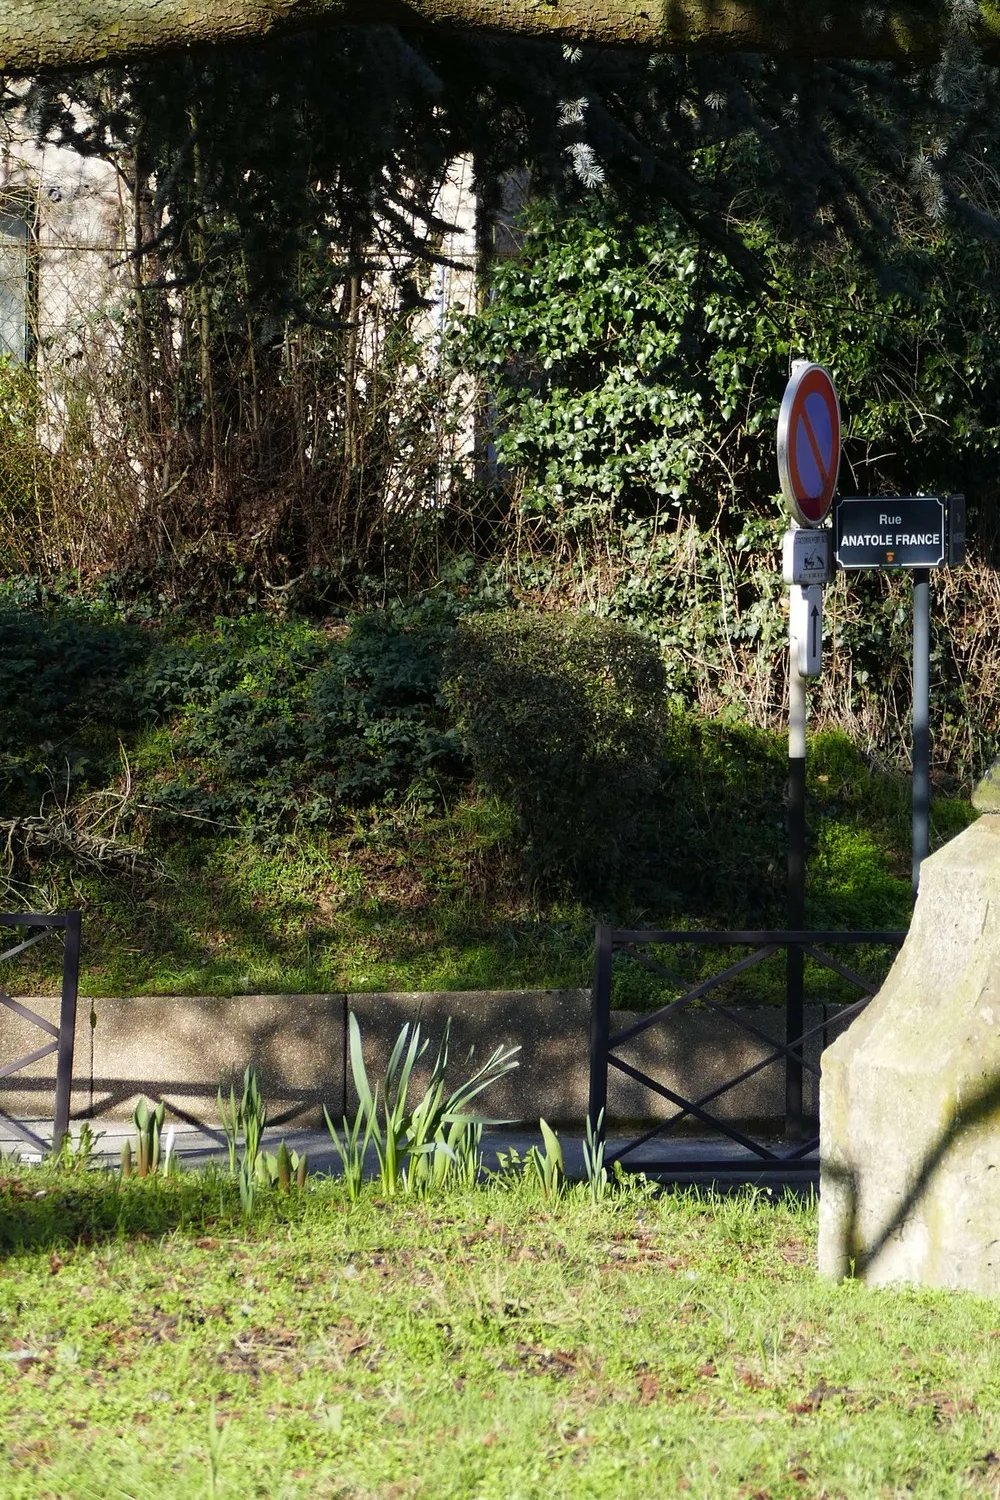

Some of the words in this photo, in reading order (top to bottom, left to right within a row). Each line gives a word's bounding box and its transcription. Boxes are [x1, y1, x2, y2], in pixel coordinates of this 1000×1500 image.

[880, 514, 902, 525] Rue
[841, 535, 892, 546] ANATOLE
[896, 534, 940, 545] FRANCE
